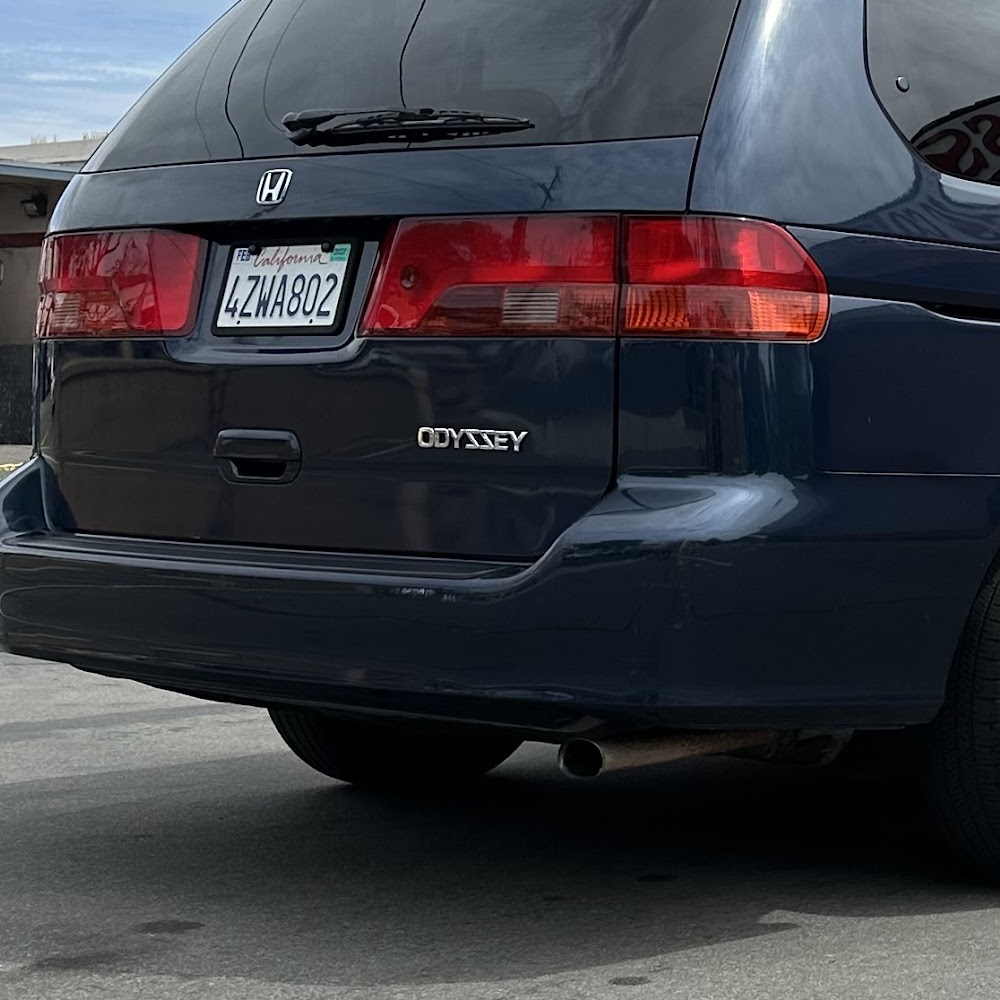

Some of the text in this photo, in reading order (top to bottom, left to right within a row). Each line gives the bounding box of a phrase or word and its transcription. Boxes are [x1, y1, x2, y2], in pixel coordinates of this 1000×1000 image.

[254, 246, 329, 273] California
[224, 273, 339, 318] 4ZWA802
[417, 426, 528, 452] ODYSSEY
